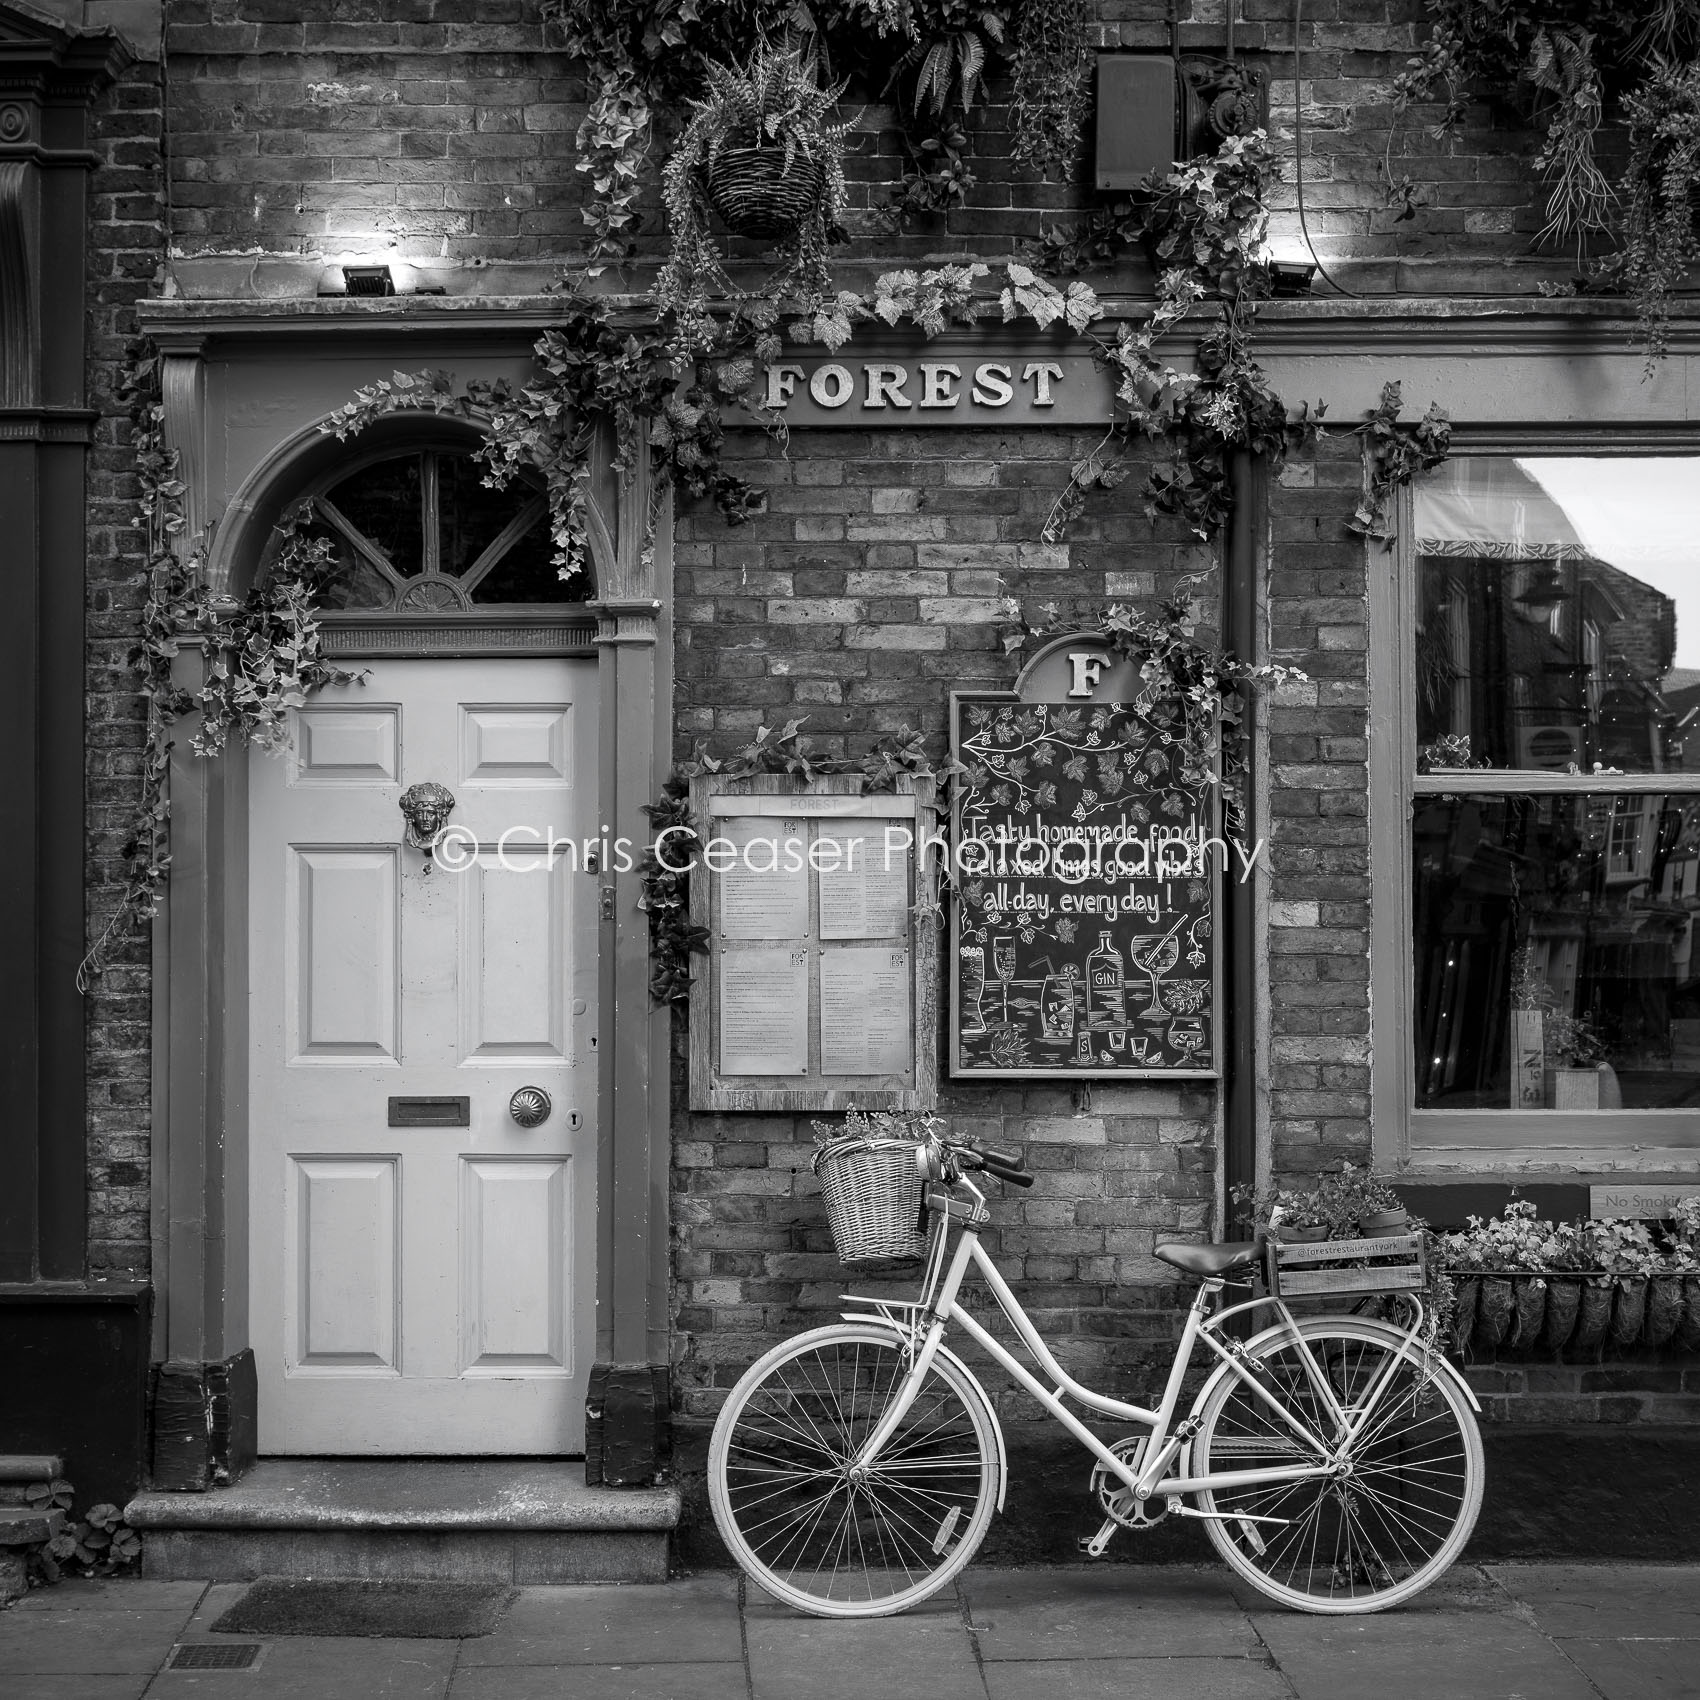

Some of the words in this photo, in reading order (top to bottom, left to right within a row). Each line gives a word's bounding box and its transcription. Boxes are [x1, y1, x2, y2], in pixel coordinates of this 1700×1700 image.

[763, 363, 1064, 408] FOREST
[1068, 653, 1111, 696] F
[790, 798, 839, 810] FOREST
[962, 814, 1031, 850] Tasty
[1036, 813, 1139, 843] homemade
[966, 849, 1045, 877] relaxed
[1095, 972, 1116, 985] GIN
[1080, 1040, 1088, 1052] S
[1606, 1195, 1628, 1207] No
[1632, 1194, 1678, 1208] Smoki
[1297, 1242, 1398, 1258] @forestrestaurantyork
